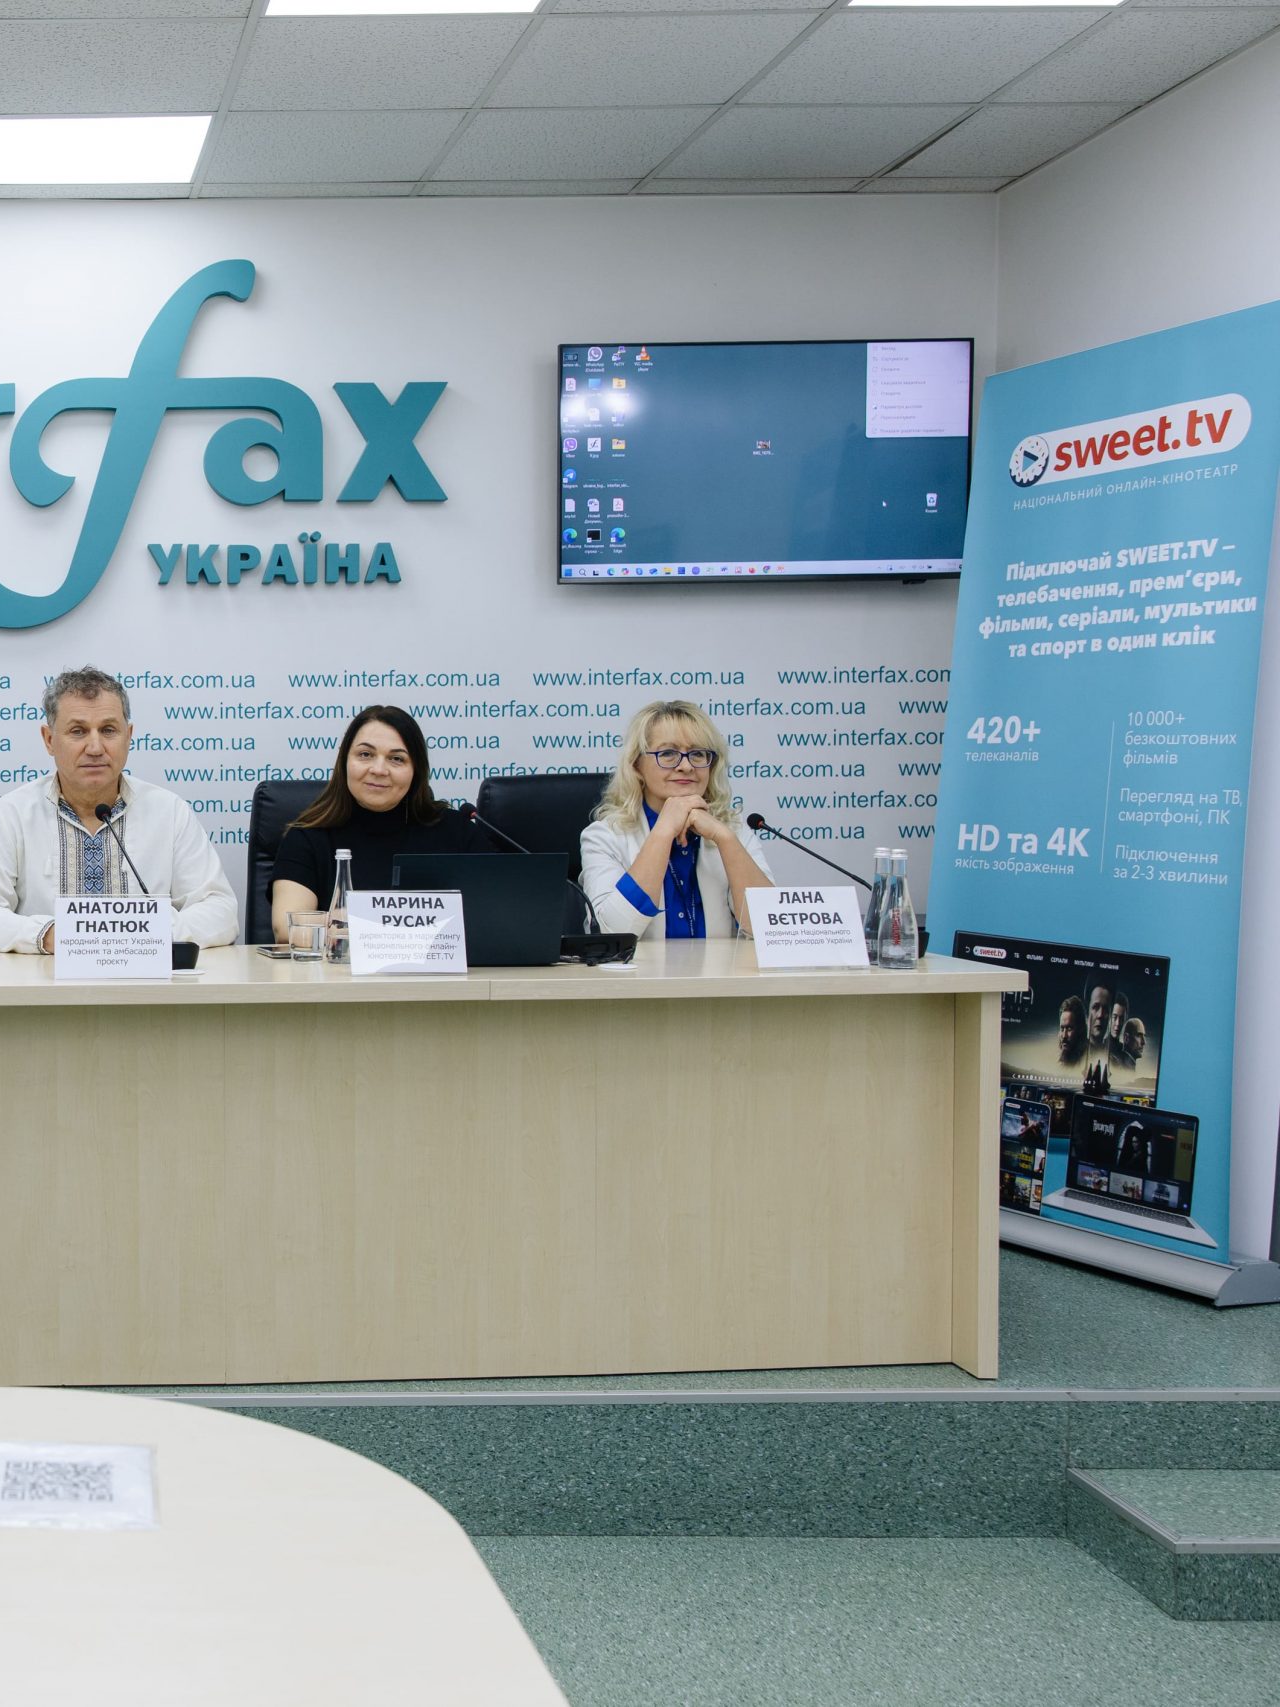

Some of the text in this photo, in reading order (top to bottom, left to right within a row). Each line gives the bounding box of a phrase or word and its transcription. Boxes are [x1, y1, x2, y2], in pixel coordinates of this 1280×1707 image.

[1053, 408, 1233, 472] sweet.tv
[1013, 463, 1238, 511] НАЦІОНАЛЬНИЙ ОНЛАЙН-КІНОТЕАТР
[148, 531, 402, 585] УКРАЇНА
[1006, 552, 1111, 582] Підключай
[1116, 538, 1218, 568] SWEET.TV
[997, 581, 1124, 608] телебачення,
[979, 597, 1257, 639] фільми, серіали, мультики
[1009, 625, 1216, 659] та спорт в один клік
[288, 670, 500, 688] www.interfax.com.ua
[533, 668, 744, 686] www.interfax.com.ua
[409, 701, 620, 718] www.interfax.com.ua
[1127, 710, 1185, 726] 10 000+
[967, 715, 1041, 744] 420+
[1124, 731, 1237, 746] безкоштовних
[965, 749, 1039, 762] телеканалів
[1123, 751, 1178, 768] фільмів
[1120, 788, 1243, 806] Перегляд на ТВ,
[1118, 808, 1230, 827] смартфоні, ПК
[957, 824, 999, 851] HD
[1007, 833, 1038, 855] та
[1047, 827, 1090, 857] 4K
[1115, 845, 1218, 865] Підключення
[954, 857, 1074, 875] якість зображення
[1113, 865, 1228, 885] за 2-3 хвилини
[372, 896, 444, 909] МАРИНА
[779, 891, 824, 904] ЛАНА
[67, 900, 158, 914] АНАТОЛІЙ
[76, 921, 149, 933] ГНАТЮК
[382, 915, 436, 928] РУСАК
[768, 912, 843, 926] ВЄТРОВА
[60, 937, 99, 946] народний
[131, 937, 165, 946] України,
[114, 947, 157, 956] амбасадор
[96, 958, 129, 966] проєкту
